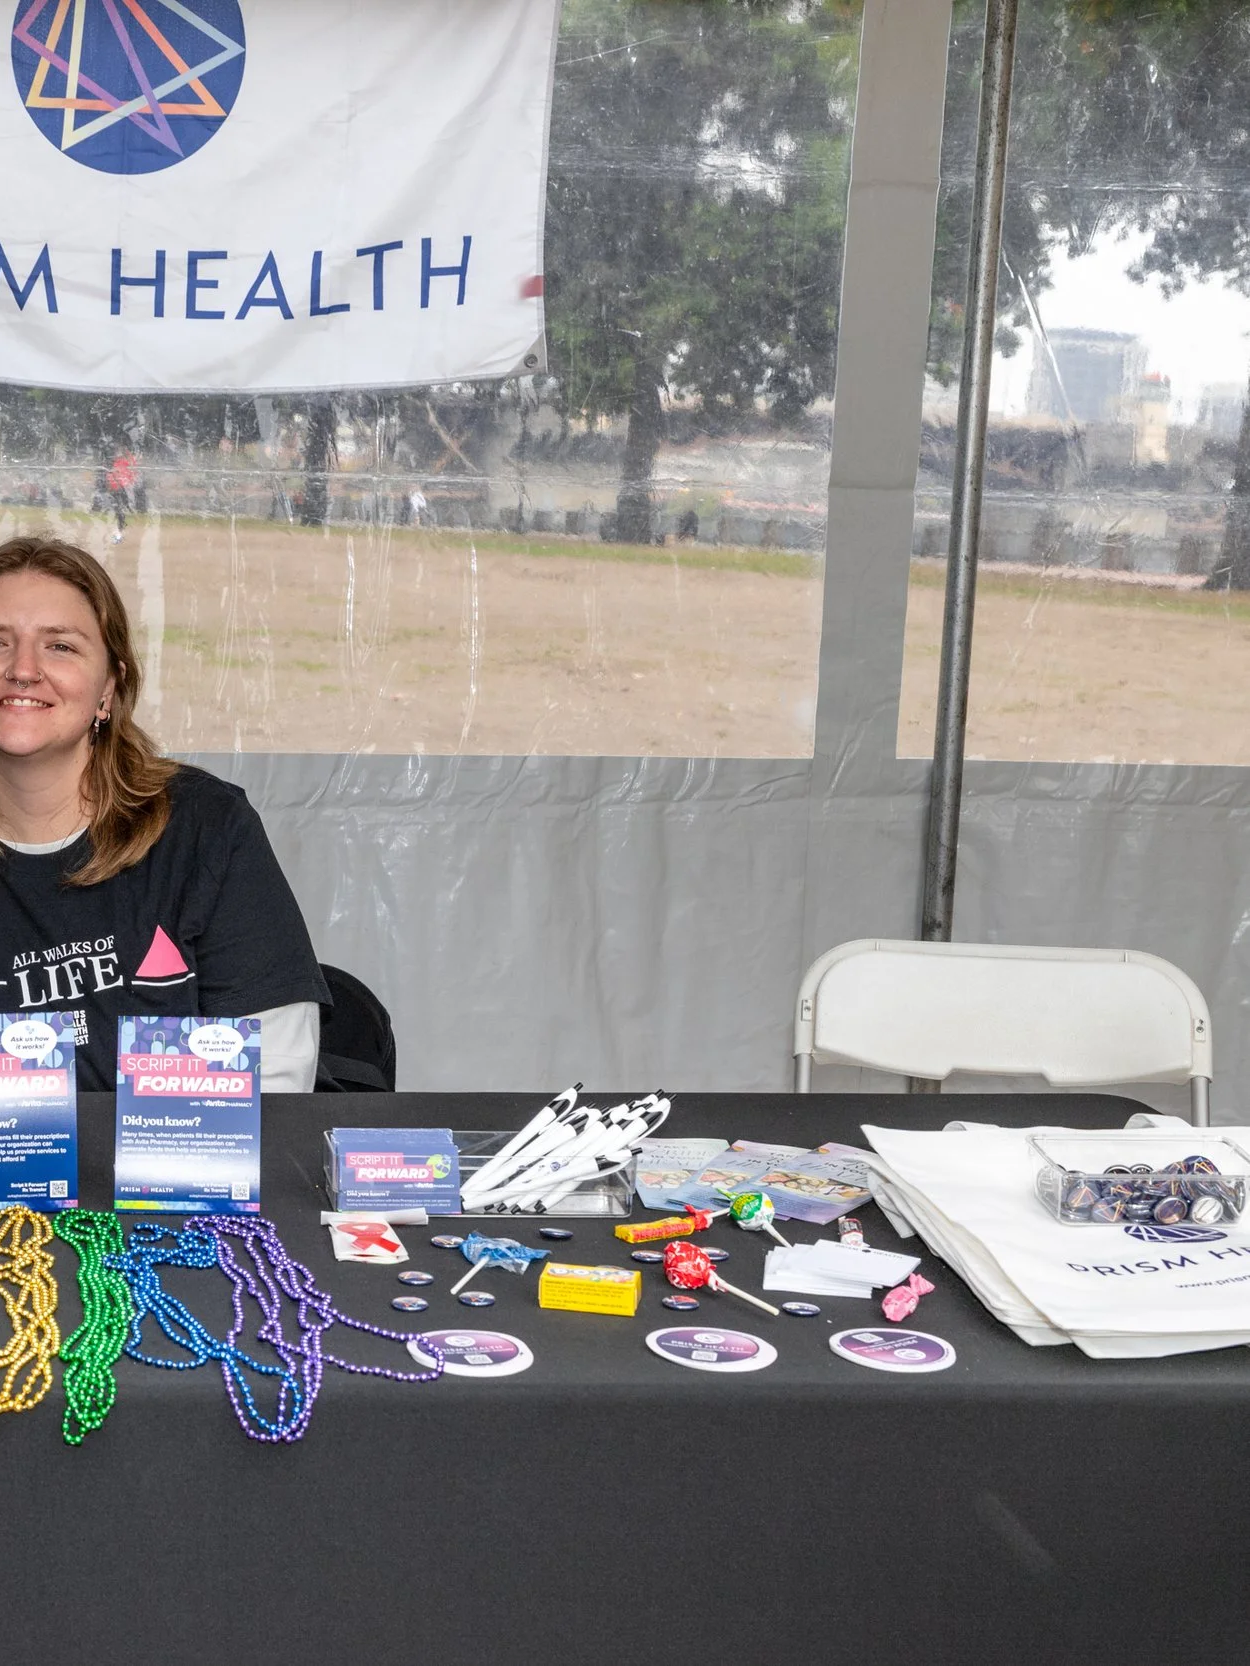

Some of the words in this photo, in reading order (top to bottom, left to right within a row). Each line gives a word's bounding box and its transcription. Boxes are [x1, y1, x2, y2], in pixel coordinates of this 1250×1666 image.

[110, 235, 473, 321] HEALTH
[12, 952, 41, 970] ALL
[42, 941, 92, 963] WALKS
[94, 935, 116, 952] OF
[14, 952, 124, 1008] LIFE
[75, 1035, 89, 1046] EST
[1, 1057, 17, 1071] IT
[126, 1057, 184, 1072] SCRIPT
[188, 1058, 202, 1072] IT
[137, 1076, 245, 1092] FORWARD
[122, 1115, 142, 1126] Did
[142, 1117, 164, 1128] you
[165, 1116, 202, 1127] know?
[34, 1133, 70, 1141] prescriptions
[15, 1148, 36, 1156] provide
[350, 1155, 386, 1166] SCRIPT
[389, 1155, 399, 1165] IT
[358, 1168, 430, 1179] FORWARD
[1067, 1254, 1199, 1277] PRISM
[671, 1340, 702, 1348] PRISM
[705, 1344, 744, 1352] HEALTH
